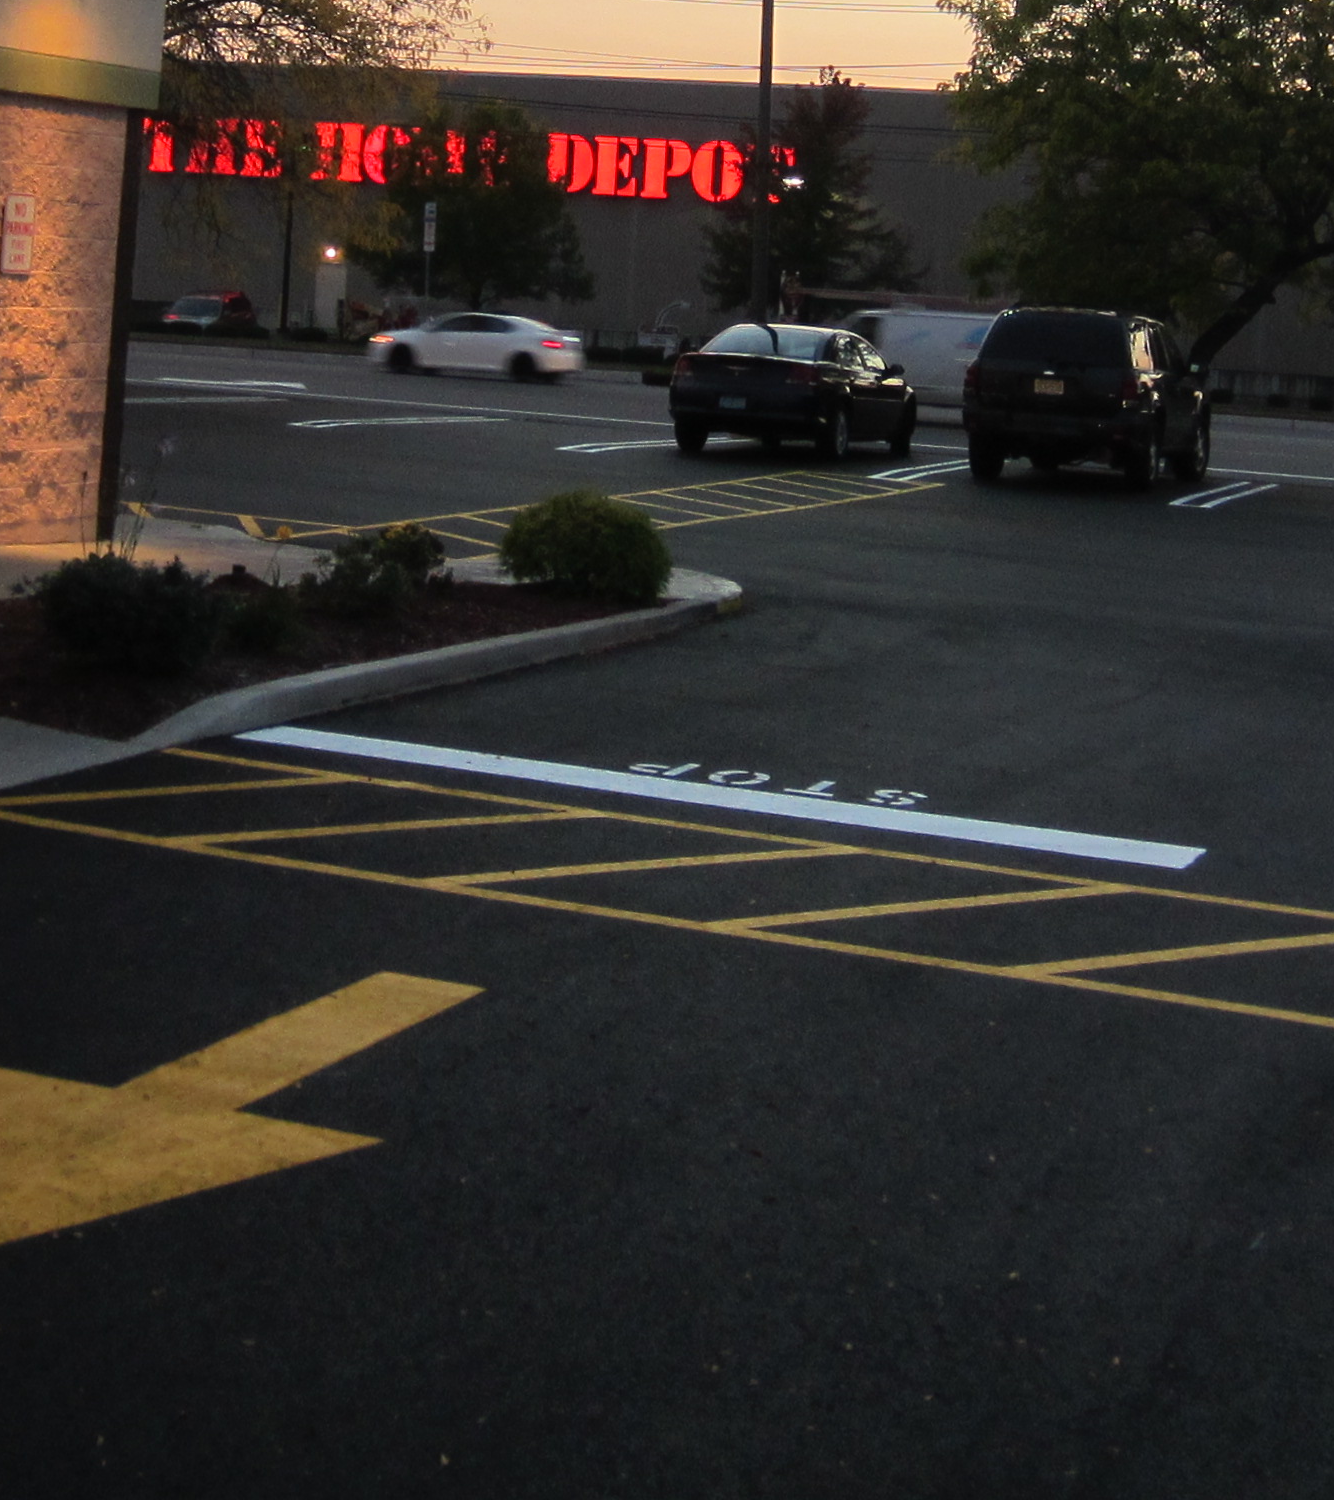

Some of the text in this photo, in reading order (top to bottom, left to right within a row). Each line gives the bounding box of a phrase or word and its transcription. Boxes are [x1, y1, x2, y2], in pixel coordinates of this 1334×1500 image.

[14, 202, 28, 218] NO
[6, 222, 34, 236] PARKING
[628, 762, 928, 807] STOP
